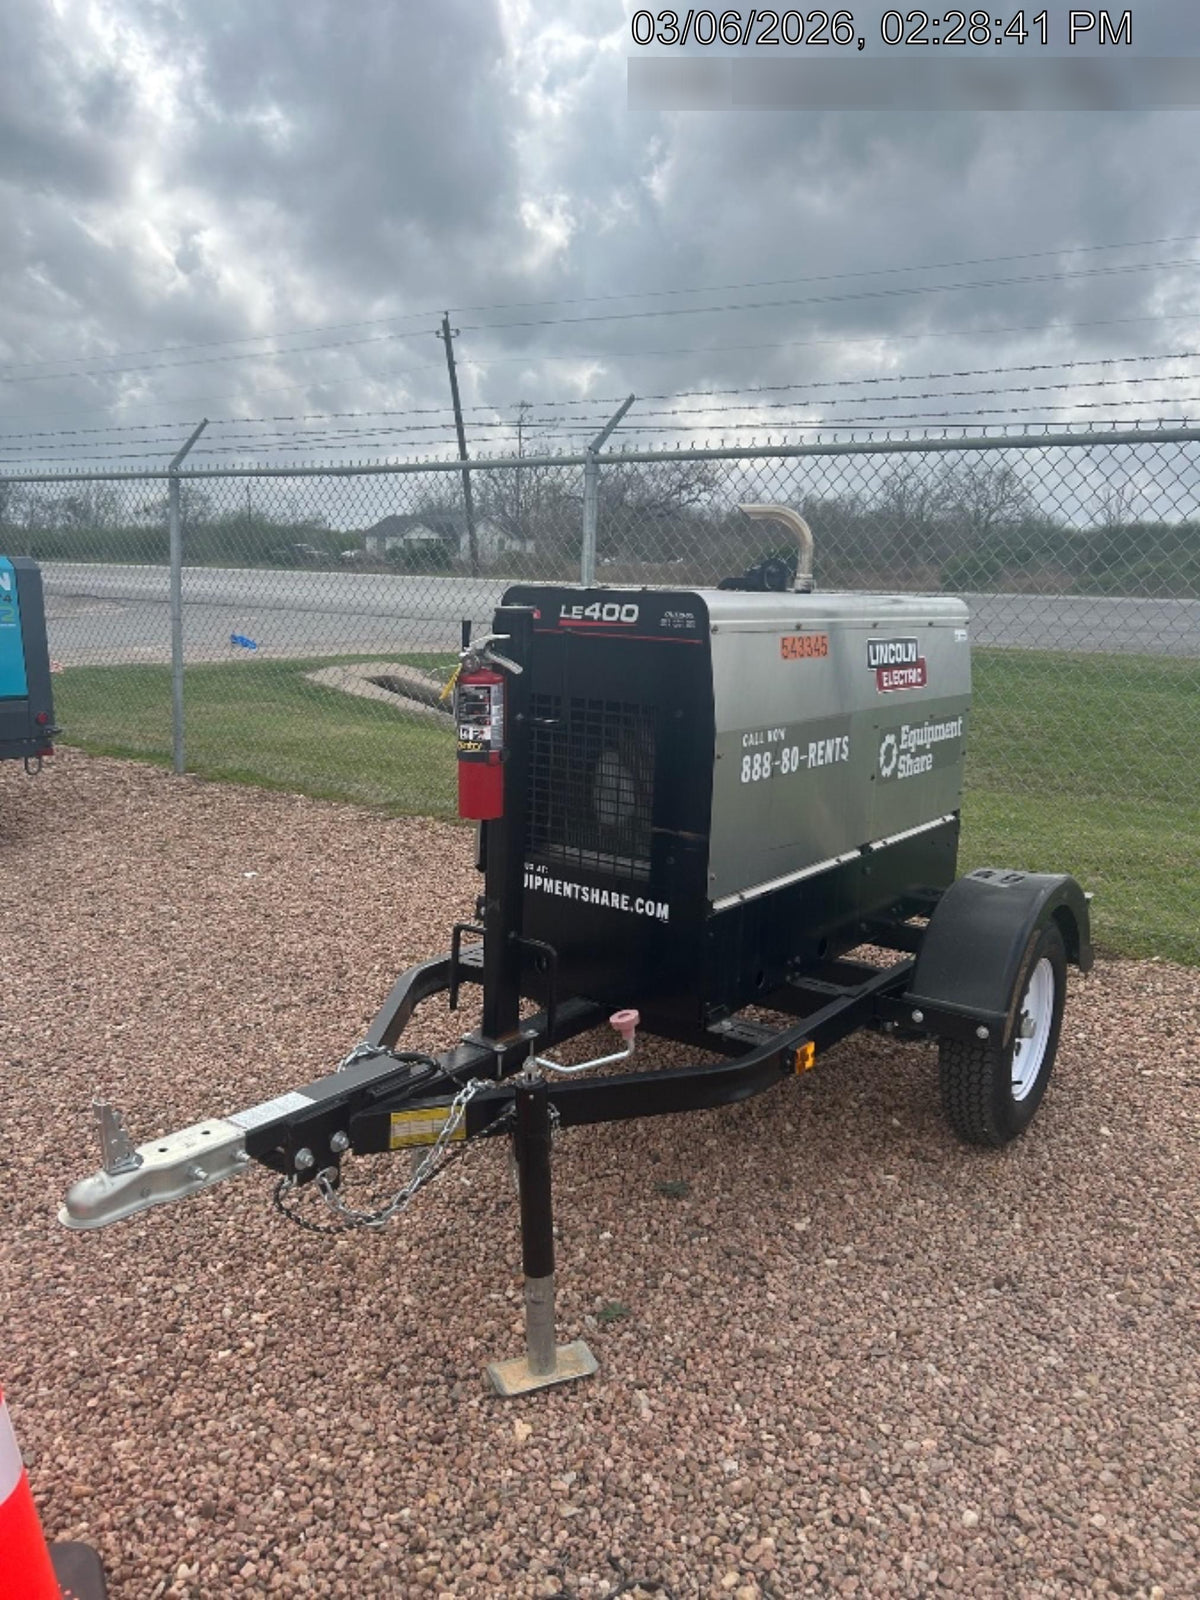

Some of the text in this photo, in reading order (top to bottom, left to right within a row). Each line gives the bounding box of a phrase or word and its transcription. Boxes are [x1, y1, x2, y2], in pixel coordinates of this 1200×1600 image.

[559, 602, 639, 622] LE400
[781, 636, 828, 659] 543345
[869, 642, 917, 666] LINCOLN
[882, 668, 922, 687] ELECTRIC
[742, 730, 764, 747] CALL
[899, 716, 964, 750] Equipment
[741, 736, 850, 783] 888-80-RENTS
[897, 752, 933, 779] Share
